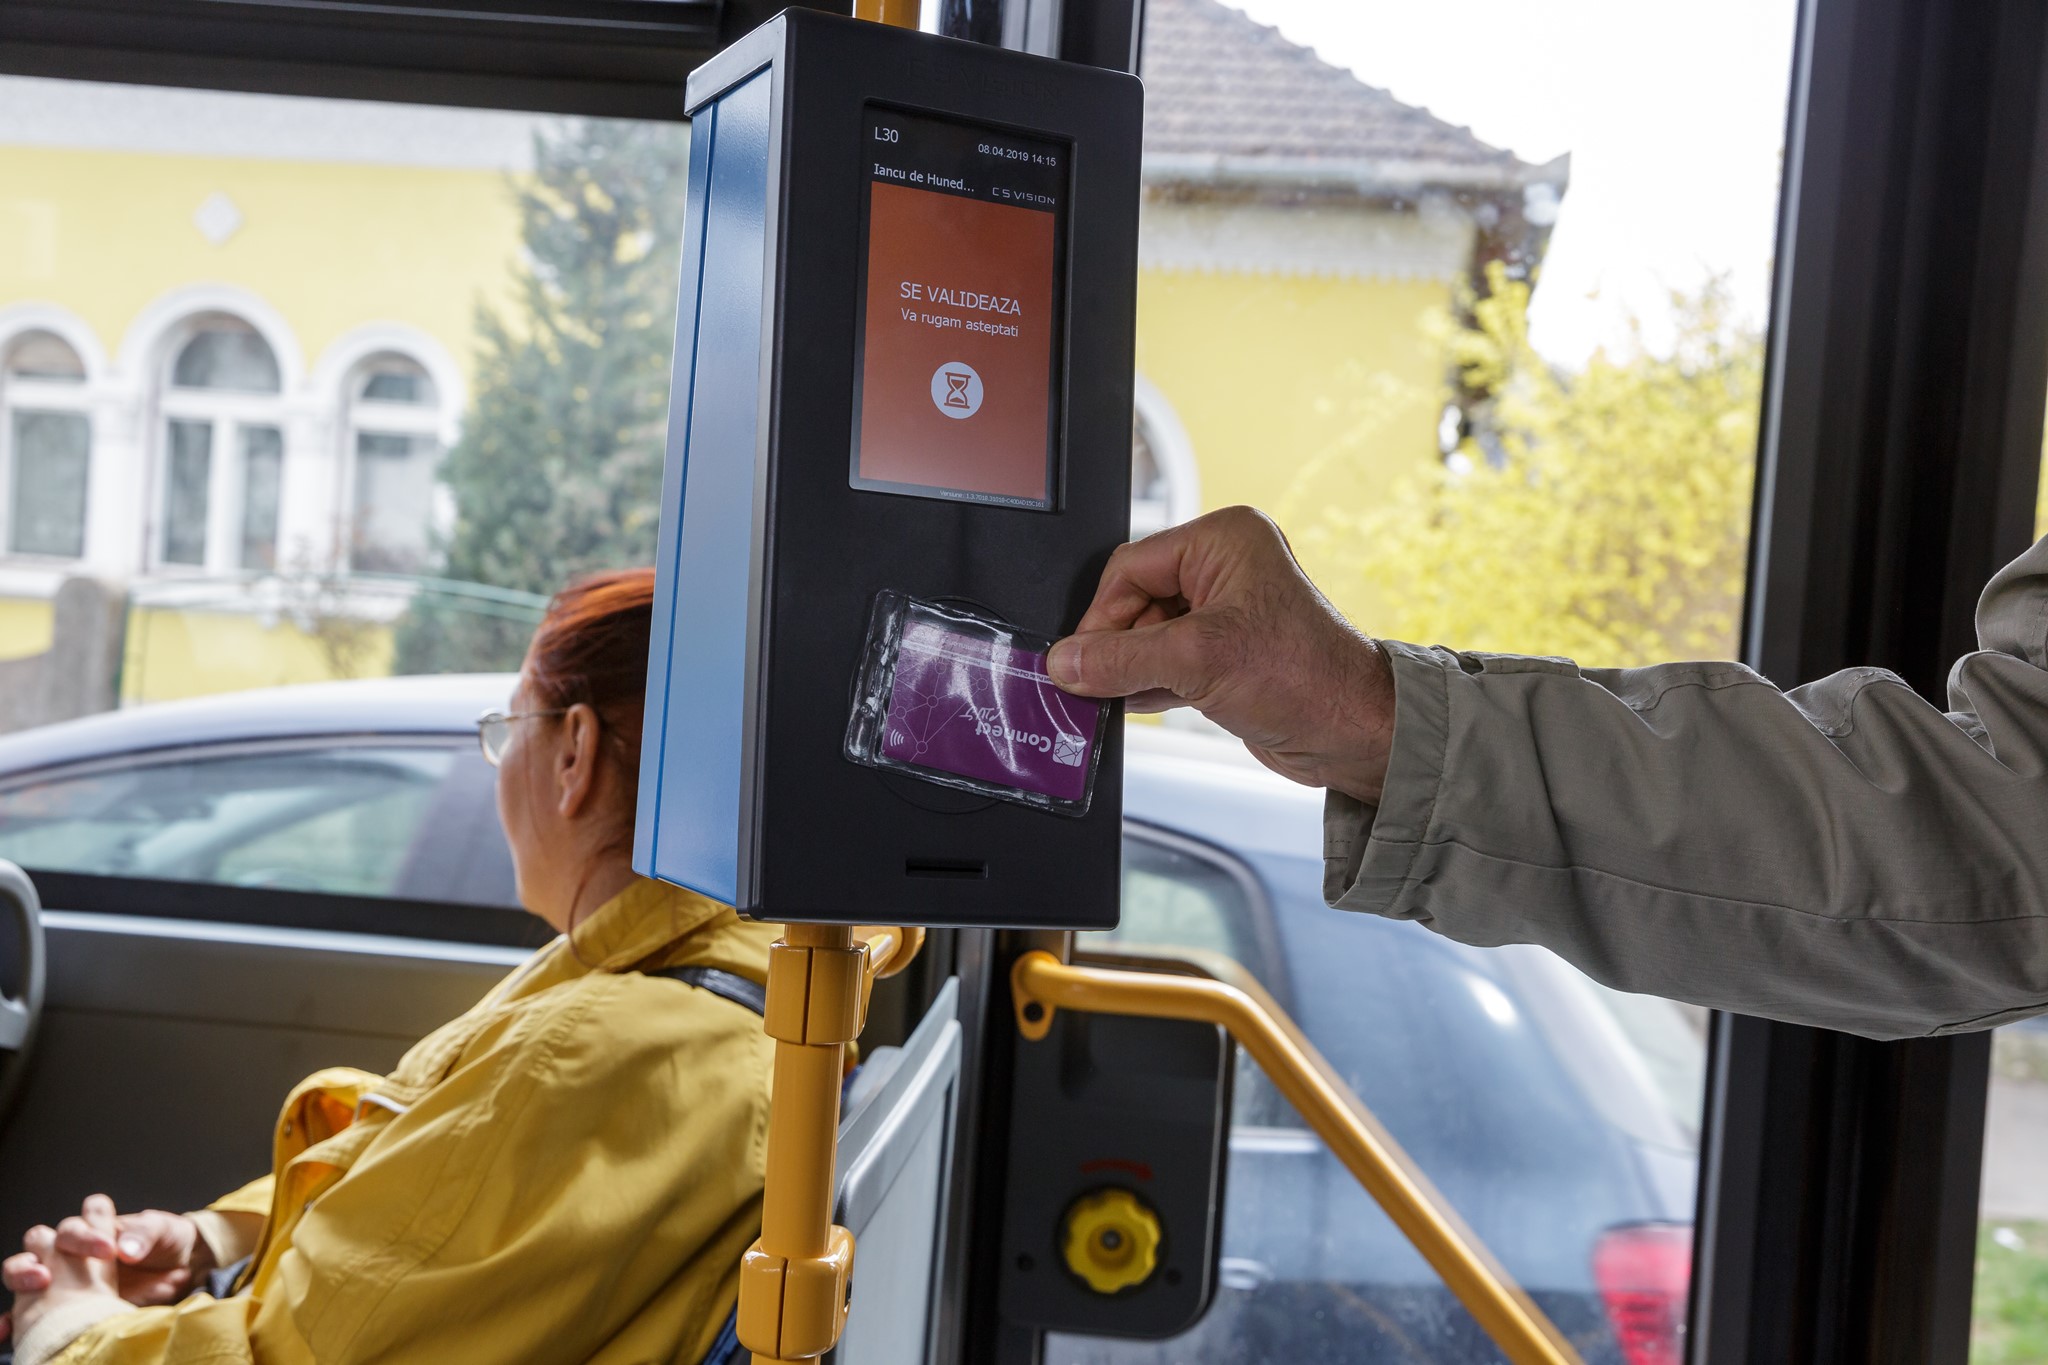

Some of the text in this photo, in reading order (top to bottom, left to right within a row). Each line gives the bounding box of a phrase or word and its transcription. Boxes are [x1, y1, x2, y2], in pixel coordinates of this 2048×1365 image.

[874, 126, 899, 143] L30
[977, 143, 1057, 167] 08.04.2019 14:15
[873, 163, 975, 192] Iancu de Huned...
[1013, 190, 1055, 205] VISION
[900, 281, 1021, 316] SE VALIDEAZA
[901, 307, 1019, 337] Va rugam asteptati
[975, 721, 1052, 753] Connect
